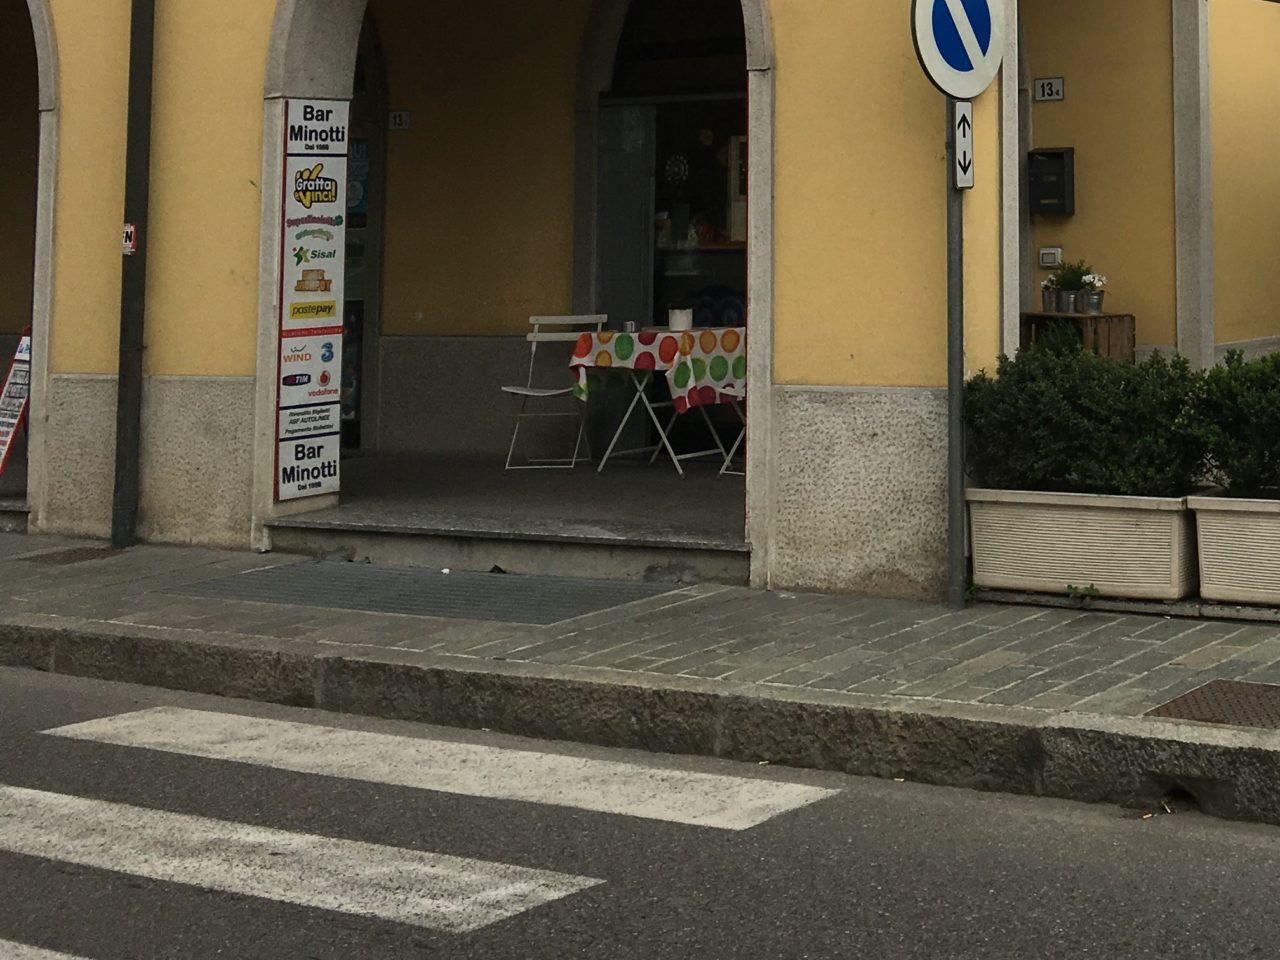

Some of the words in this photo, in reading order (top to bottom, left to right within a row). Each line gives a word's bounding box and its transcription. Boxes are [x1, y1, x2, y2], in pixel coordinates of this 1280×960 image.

[303, 104, 333, 122] Bar
[289, 125, 345, 142] Minotti
[296, 178, 331, 191] Gratta
[310, 249, 337, 259] Sisal
[292, 304, 333, 317] postepay
[283, 353, 312, 363] WIND
[295, 375, 309, 384] TIM
[307, 388, 338, 397] vodafone
[294, 443, 324, 461] Bar
[282, 460, 337, 484] Minotti
